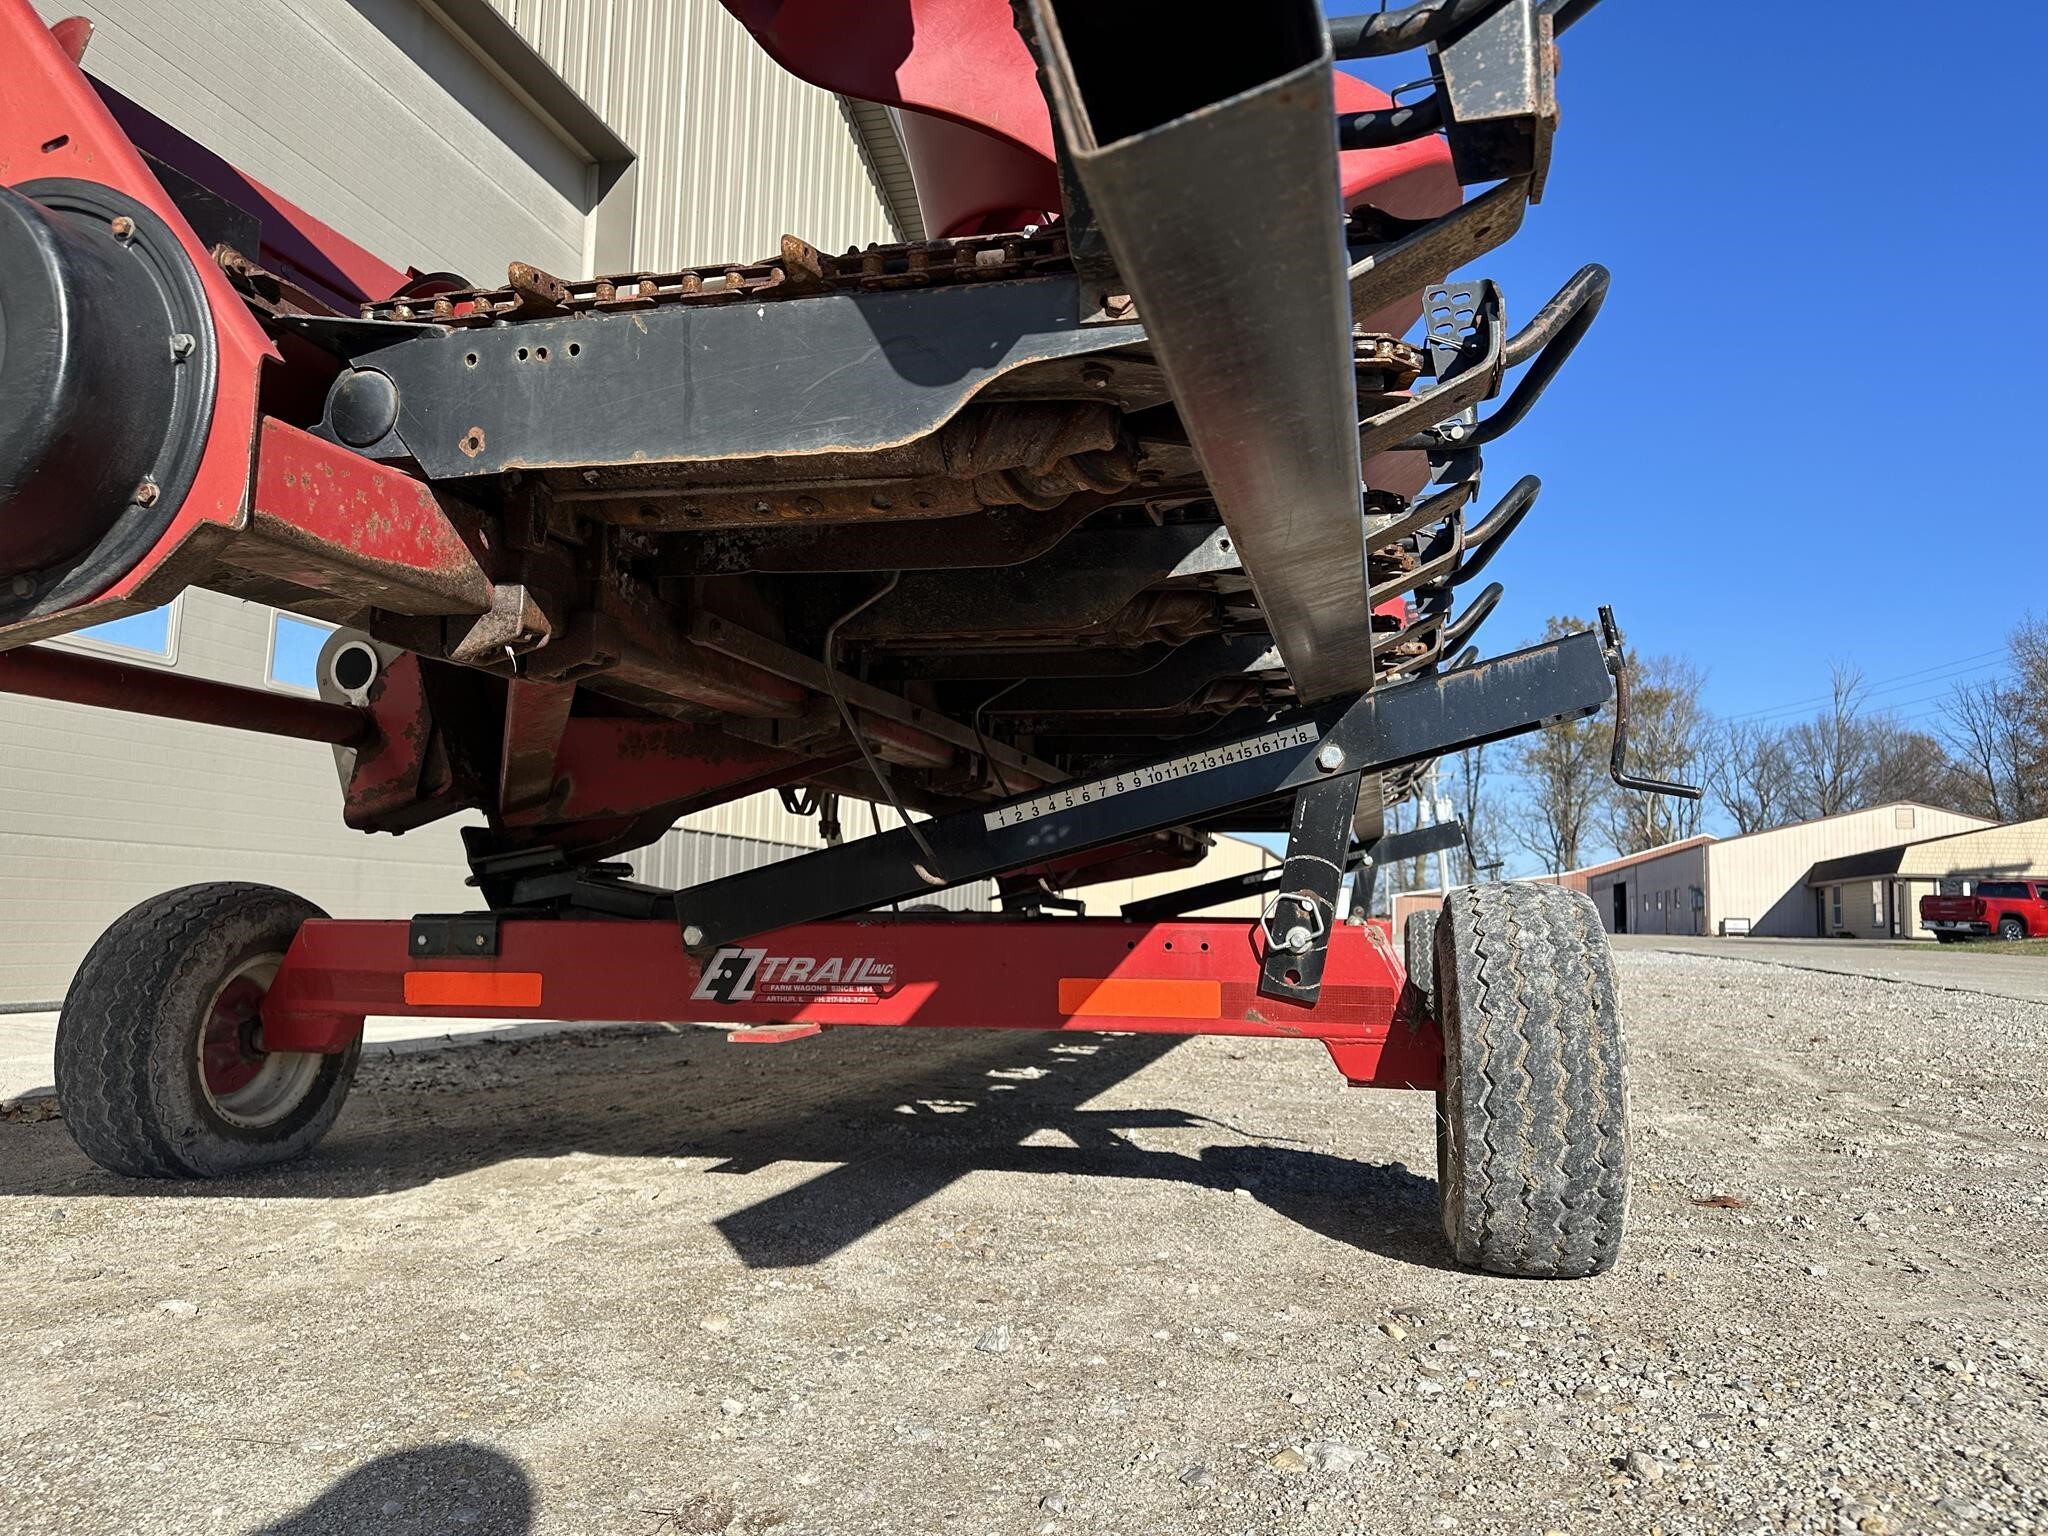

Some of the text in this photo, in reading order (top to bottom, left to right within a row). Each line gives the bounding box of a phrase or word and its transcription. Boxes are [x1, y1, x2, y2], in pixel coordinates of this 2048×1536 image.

[999, 816, 1005, 826] 1
[1016, 811, 1023, 821] 2
[1032, 806, 1039, 817] 3
[1048, 801, 1056, 811] 4
[1065, 796, 1073, 807] 5
[1083, 791, 1090, 802] 6
[1099, 786, 1106, 797] 7
[1117, 781, 1124, 792] 8
[1133, 777, 1141, 787] 9
[1148, 771, 1163, 783] 10
[1165, 766, 1180, 779] 11
[1183, 761, 1198, 774] 12
[1201, 757, 1216, 770] 13
[1219, 752, 1234, 764] 14
[1237, 747, 1252, 759] 15
[1254, 742, 1270, 754] 16
[1273, 737, 1288, 750] 17
[1291, 732, 1307, 745] 18
[761, 957, 891, 983] TRAIL
[869, 963, 895, 975] INC.
